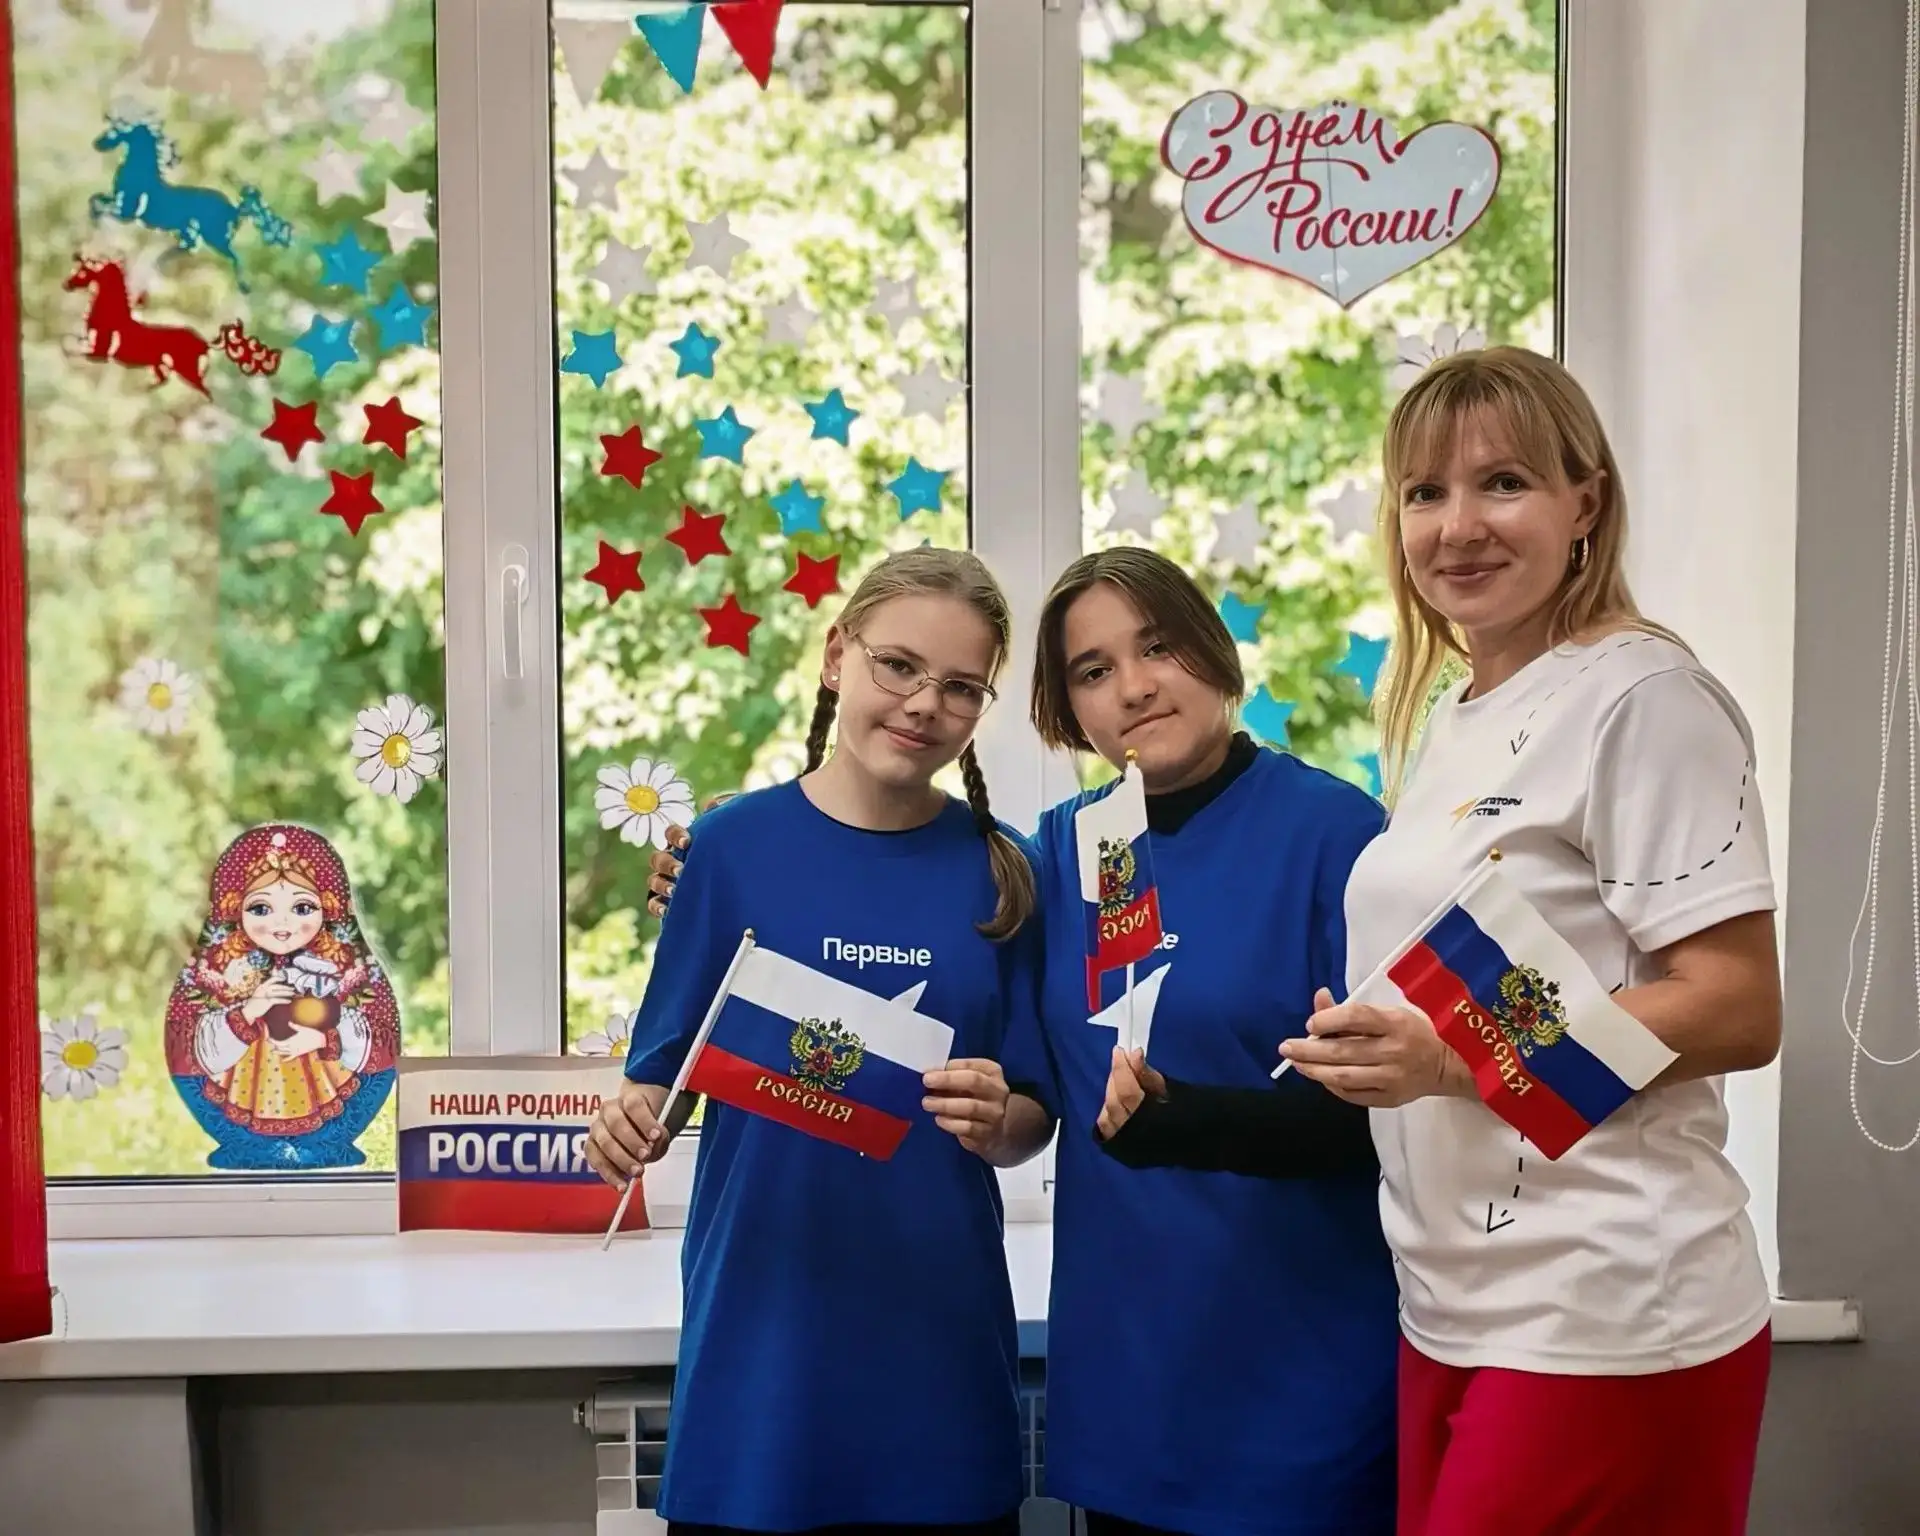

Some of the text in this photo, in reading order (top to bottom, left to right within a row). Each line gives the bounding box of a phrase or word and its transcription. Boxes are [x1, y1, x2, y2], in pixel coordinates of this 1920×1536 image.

[1203, 100, 1397, 224] днём
[1264, 179, 1464, 253] России!
[823, 937, 932, 969] Первые
[1453, 1000, 1533, 1097] РОССИЯ
[430, 1094, 601, 1120] НАША РОДИНА
[755, 1076, 853, 1123] РОССИЯ
